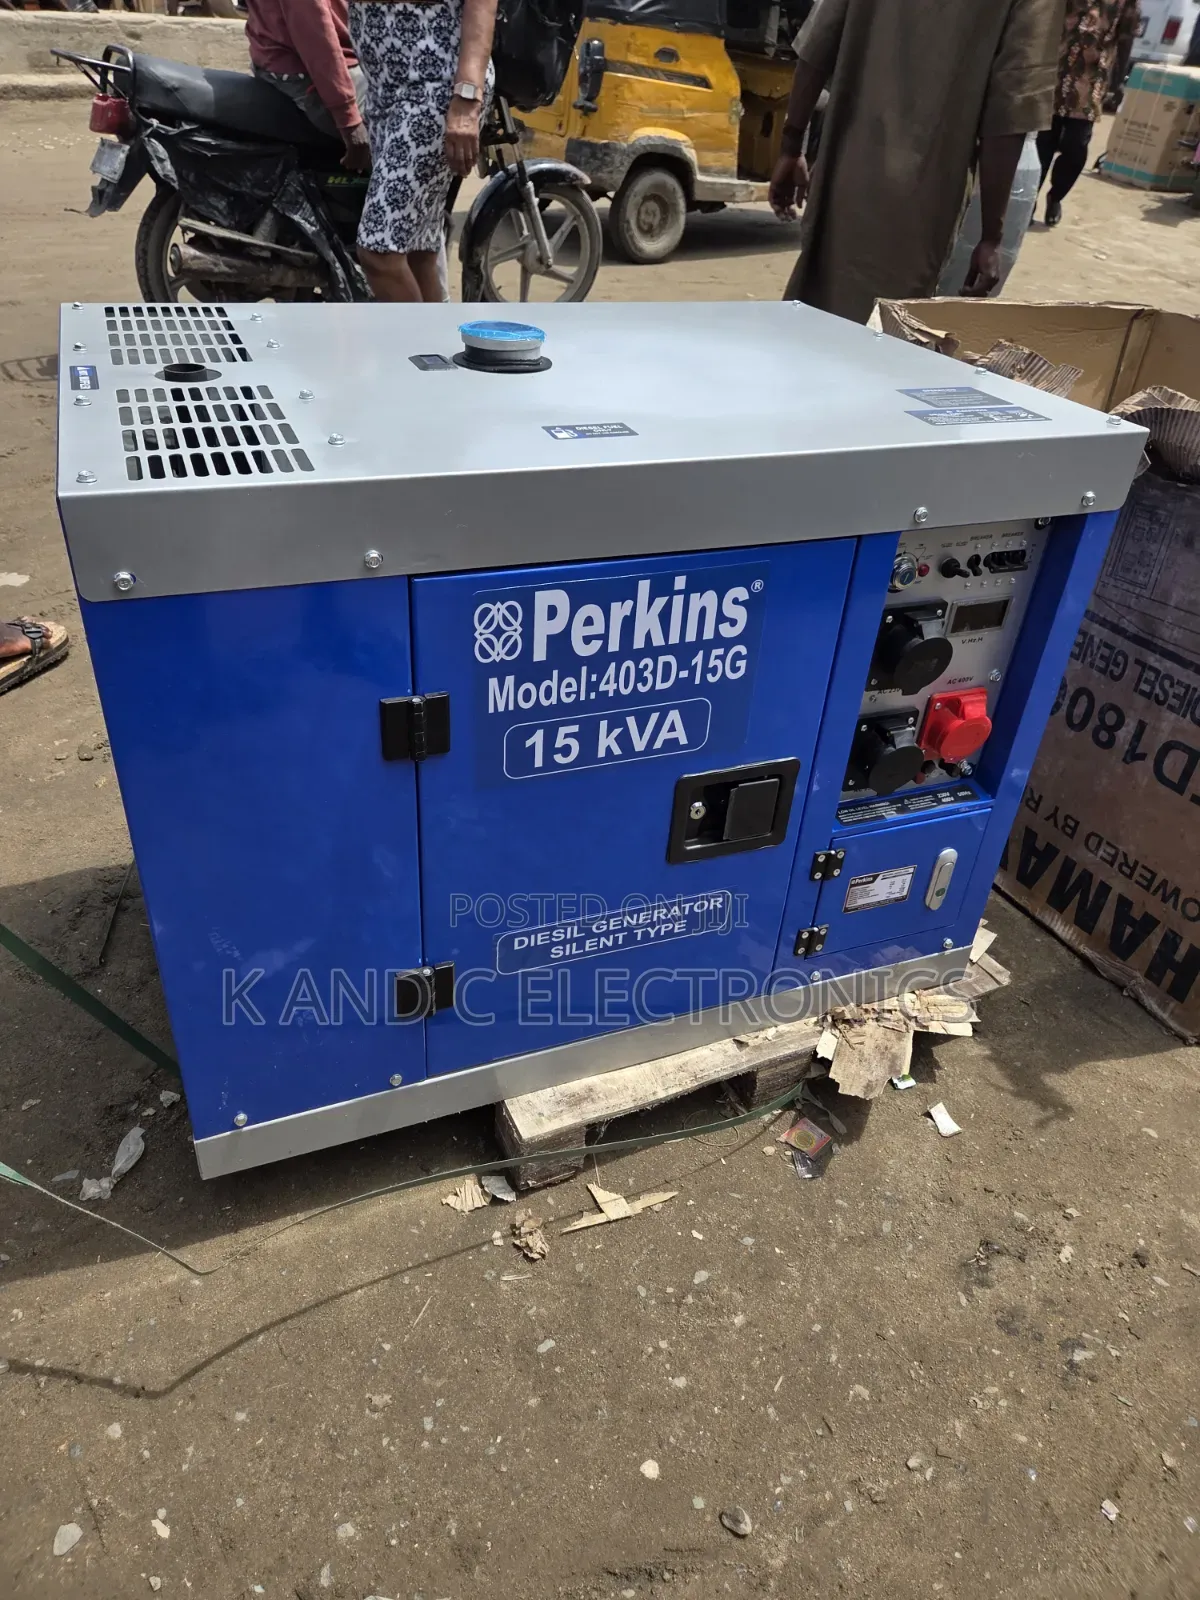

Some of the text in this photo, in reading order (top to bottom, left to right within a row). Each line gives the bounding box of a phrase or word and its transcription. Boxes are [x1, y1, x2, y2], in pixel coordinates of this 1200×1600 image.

[488, 644, 748, 713] Model:403D-15G
[1133, 658, 1200, 728] DIESEL
[524, 709, 688, 768] 15 kVA
[1044, 806, 1080, 840] BY
[513, 897, 724, 950] DIESIL GENERATOR
[550, 919, 687, 959] SILENT TYPE
